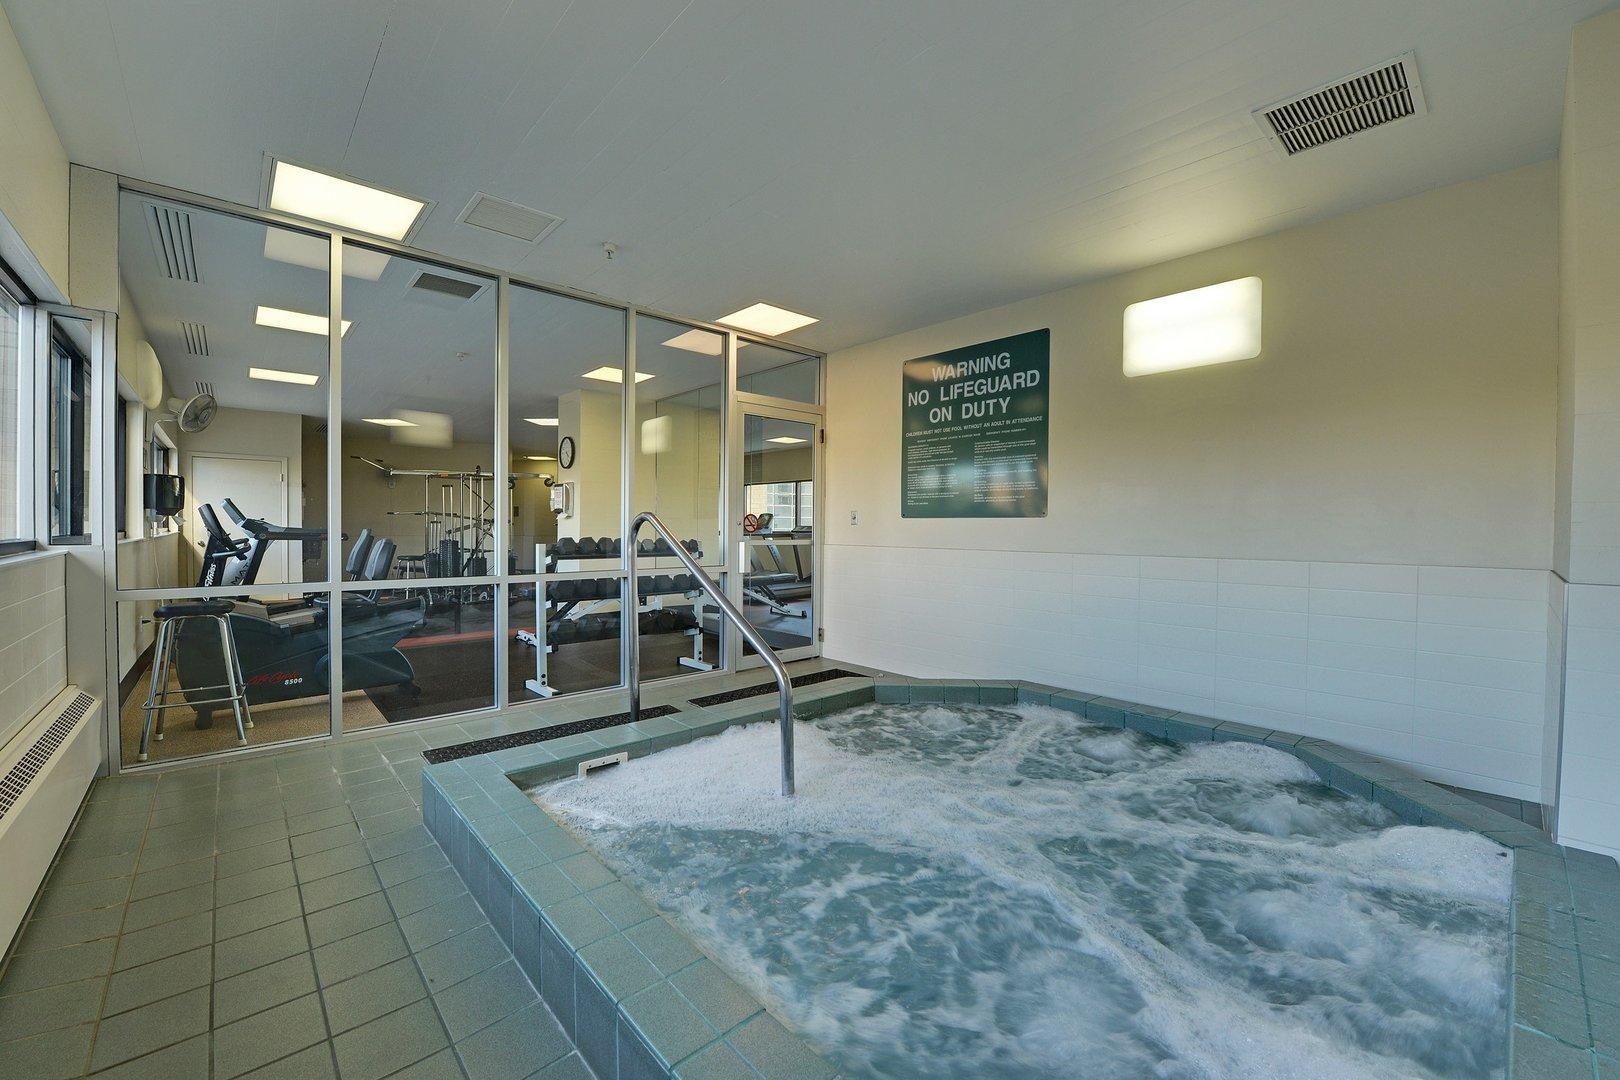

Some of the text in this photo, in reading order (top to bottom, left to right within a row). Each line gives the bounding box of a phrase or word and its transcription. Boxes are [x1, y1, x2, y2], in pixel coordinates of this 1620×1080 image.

[932, 352, 1011, 382] WARNING
[908, 369, 1040, 407] NO LIFEGUARD
[929, 397, 1011, 424] ON DUTY
[1012, 415, 1043, 424] ATTENDANCE
